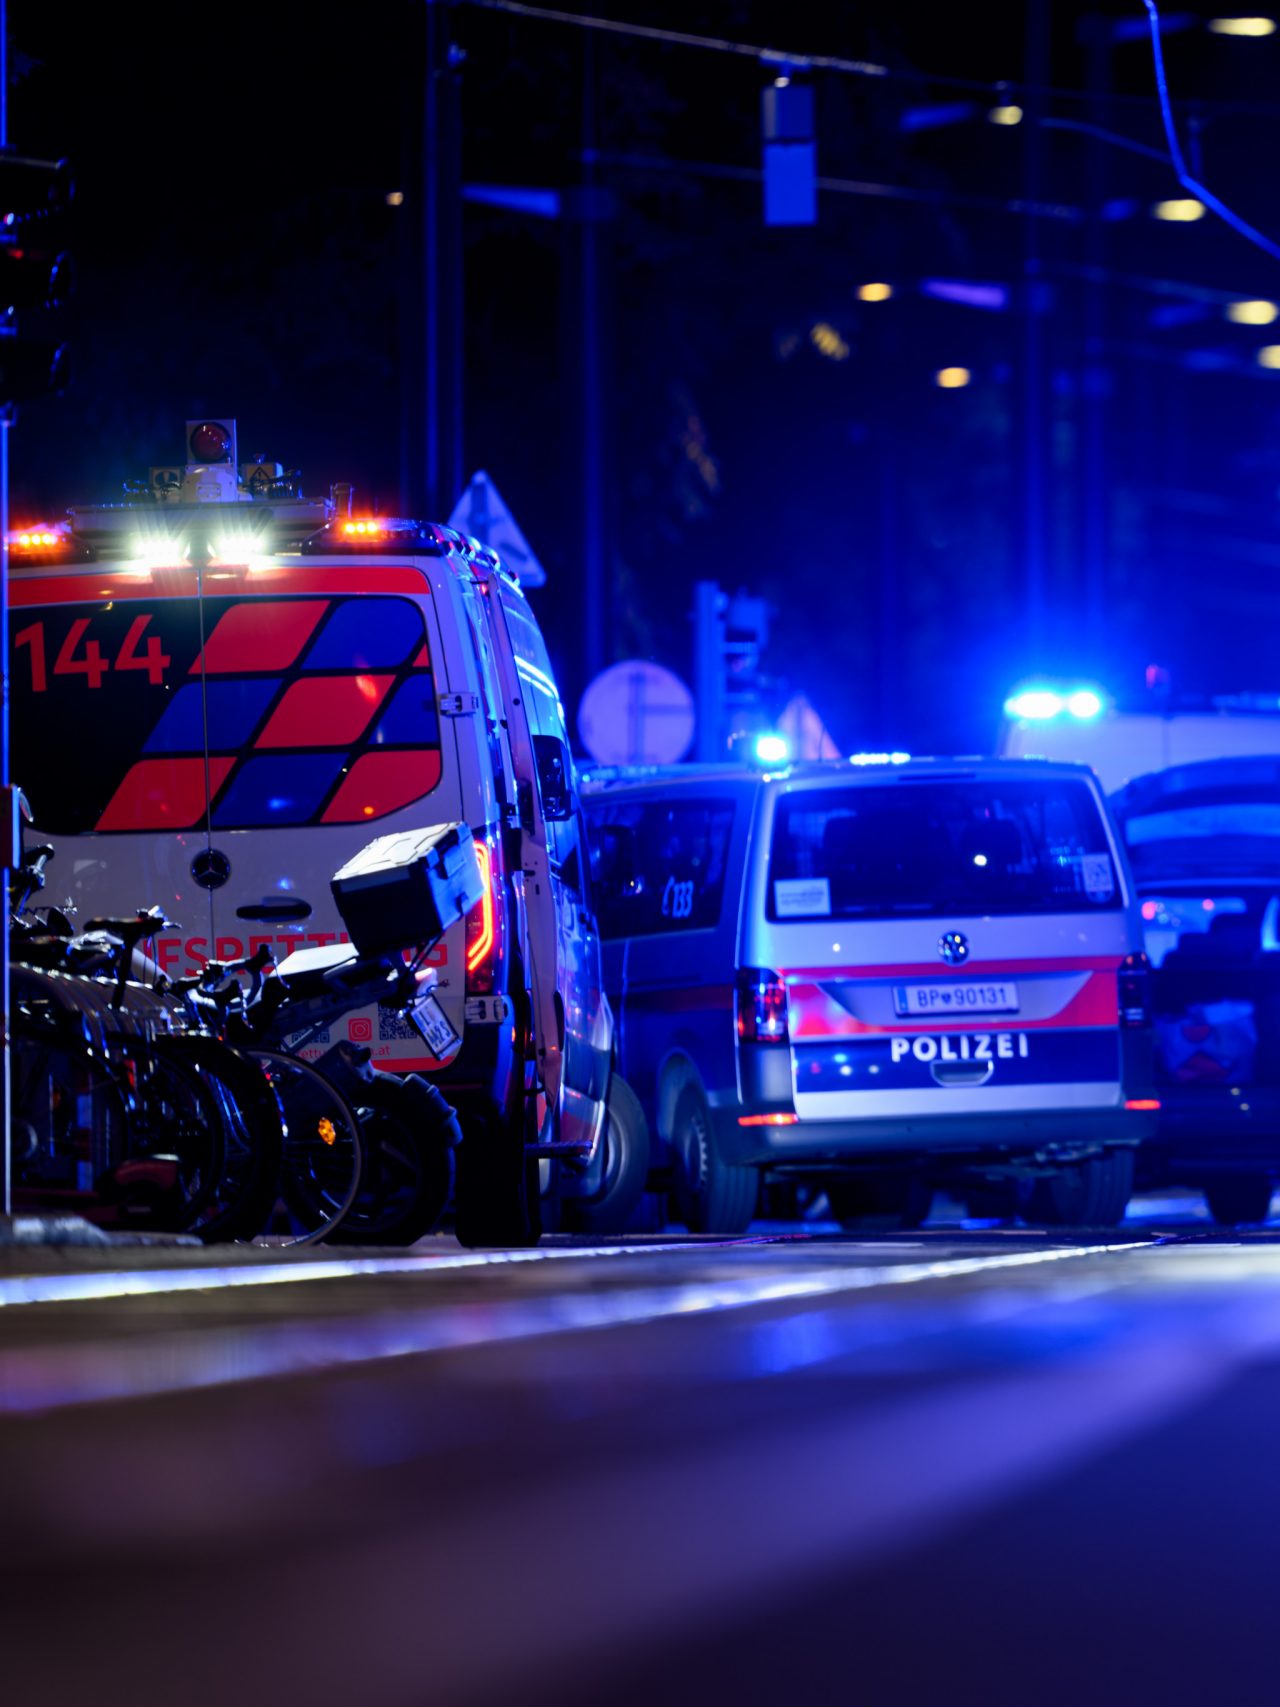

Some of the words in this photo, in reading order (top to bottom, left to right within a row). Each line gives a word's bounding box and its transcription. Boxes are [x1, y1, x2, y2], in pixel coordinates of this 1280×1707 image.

[15, 614, 171, 692] 144
[917, 989, 939, 1008] BP
[954, 987, 1006, 1006] 90131
[891, 1033, 1028, 1063] POLIZEI
